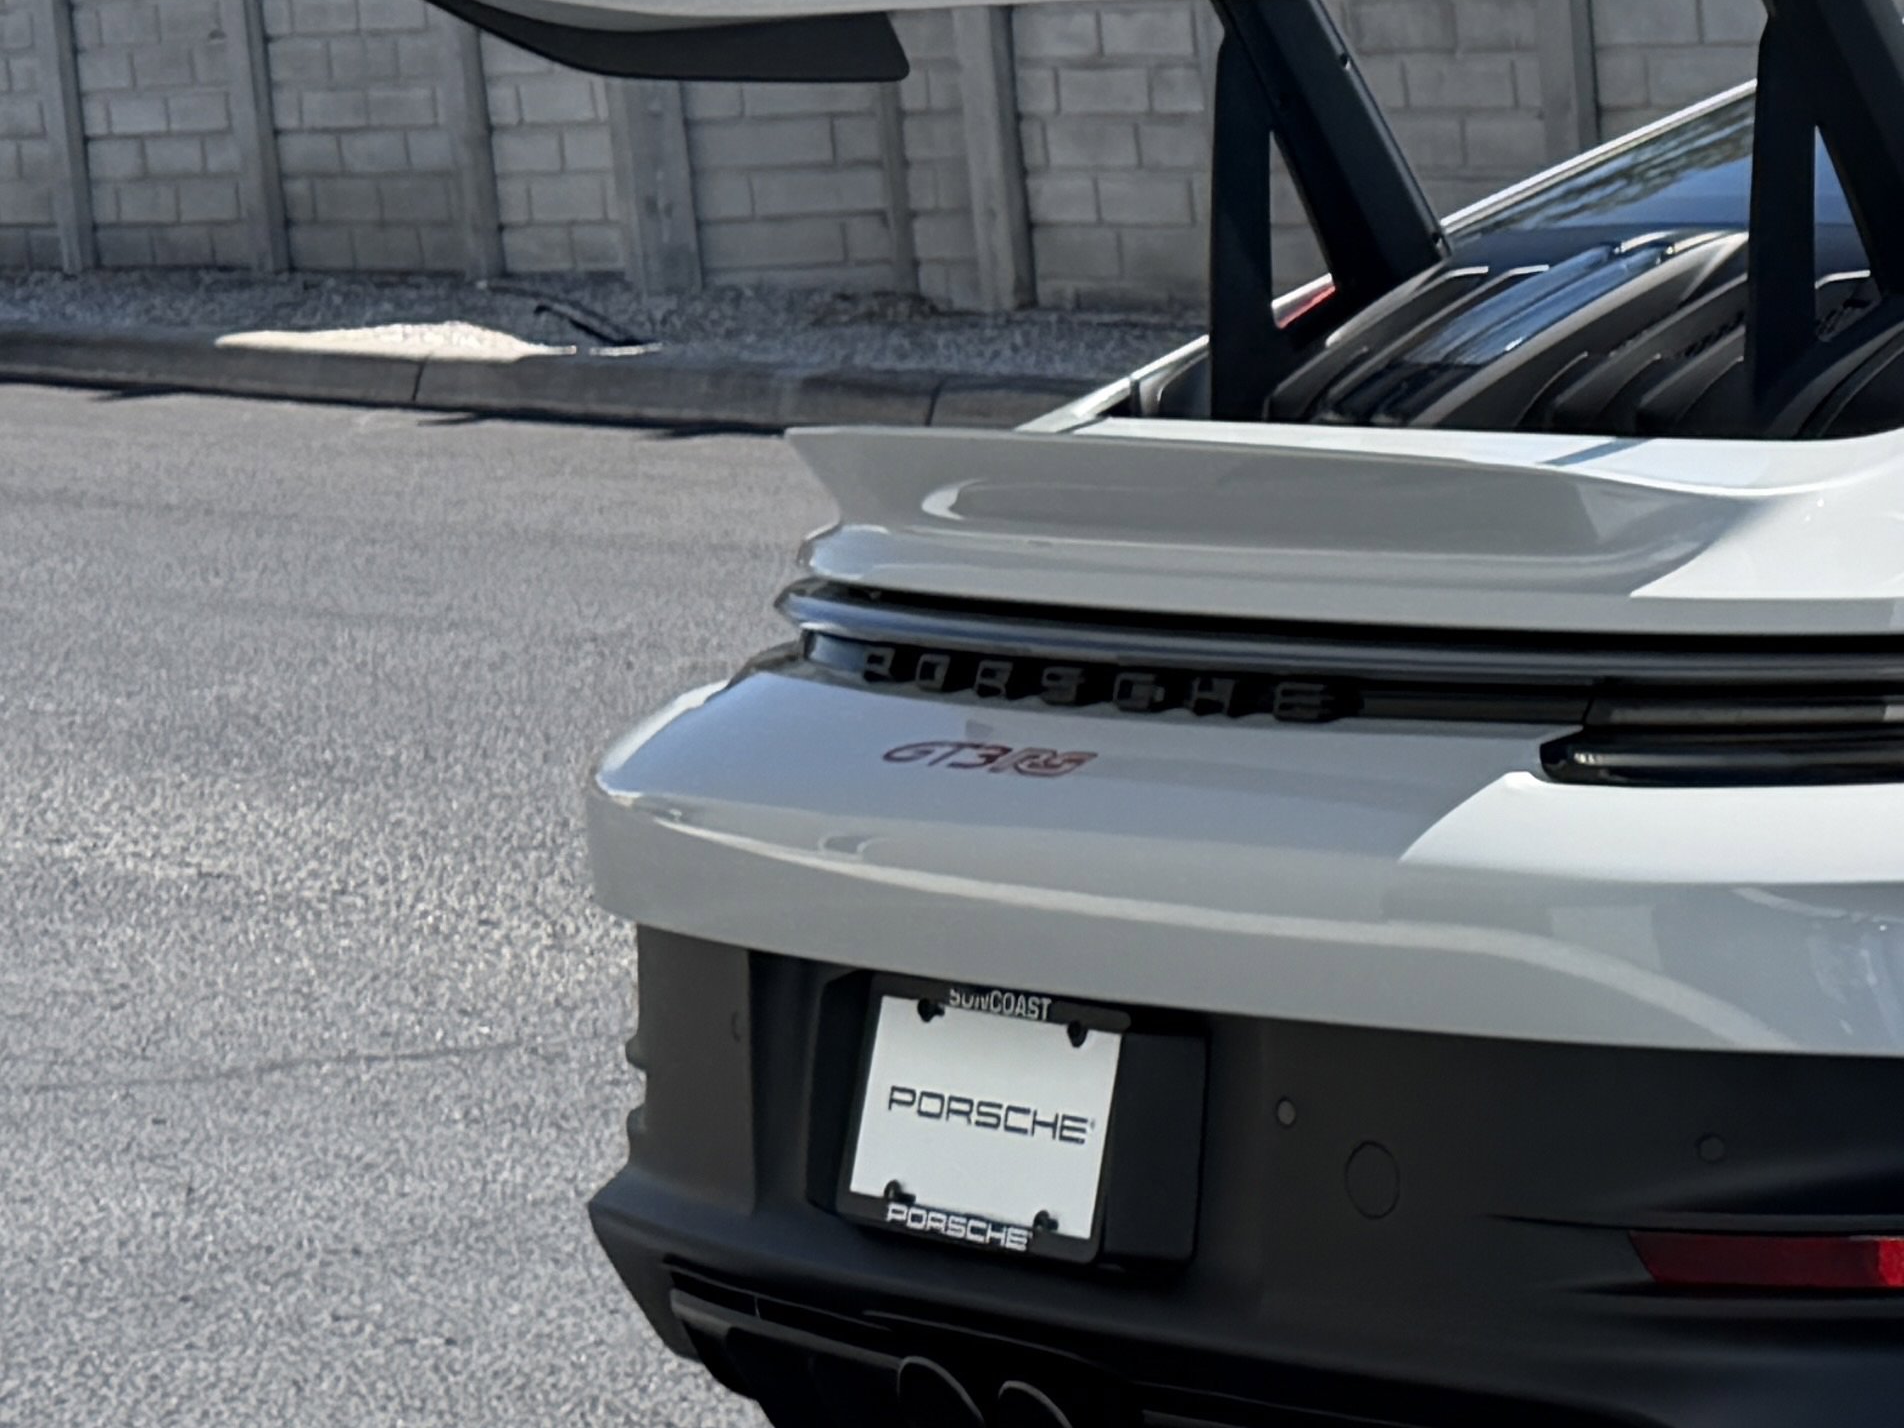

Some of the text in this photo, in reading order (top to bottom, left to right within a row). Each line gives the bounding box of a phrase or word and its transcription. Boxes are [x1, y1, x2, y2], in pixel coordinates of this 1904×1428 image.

[862, 645, 1334, 722] PORSCHE
[888, 1085, 1090, 1145] PORSCHE
[886, 1202, 1031, 1252] PORSCHE
